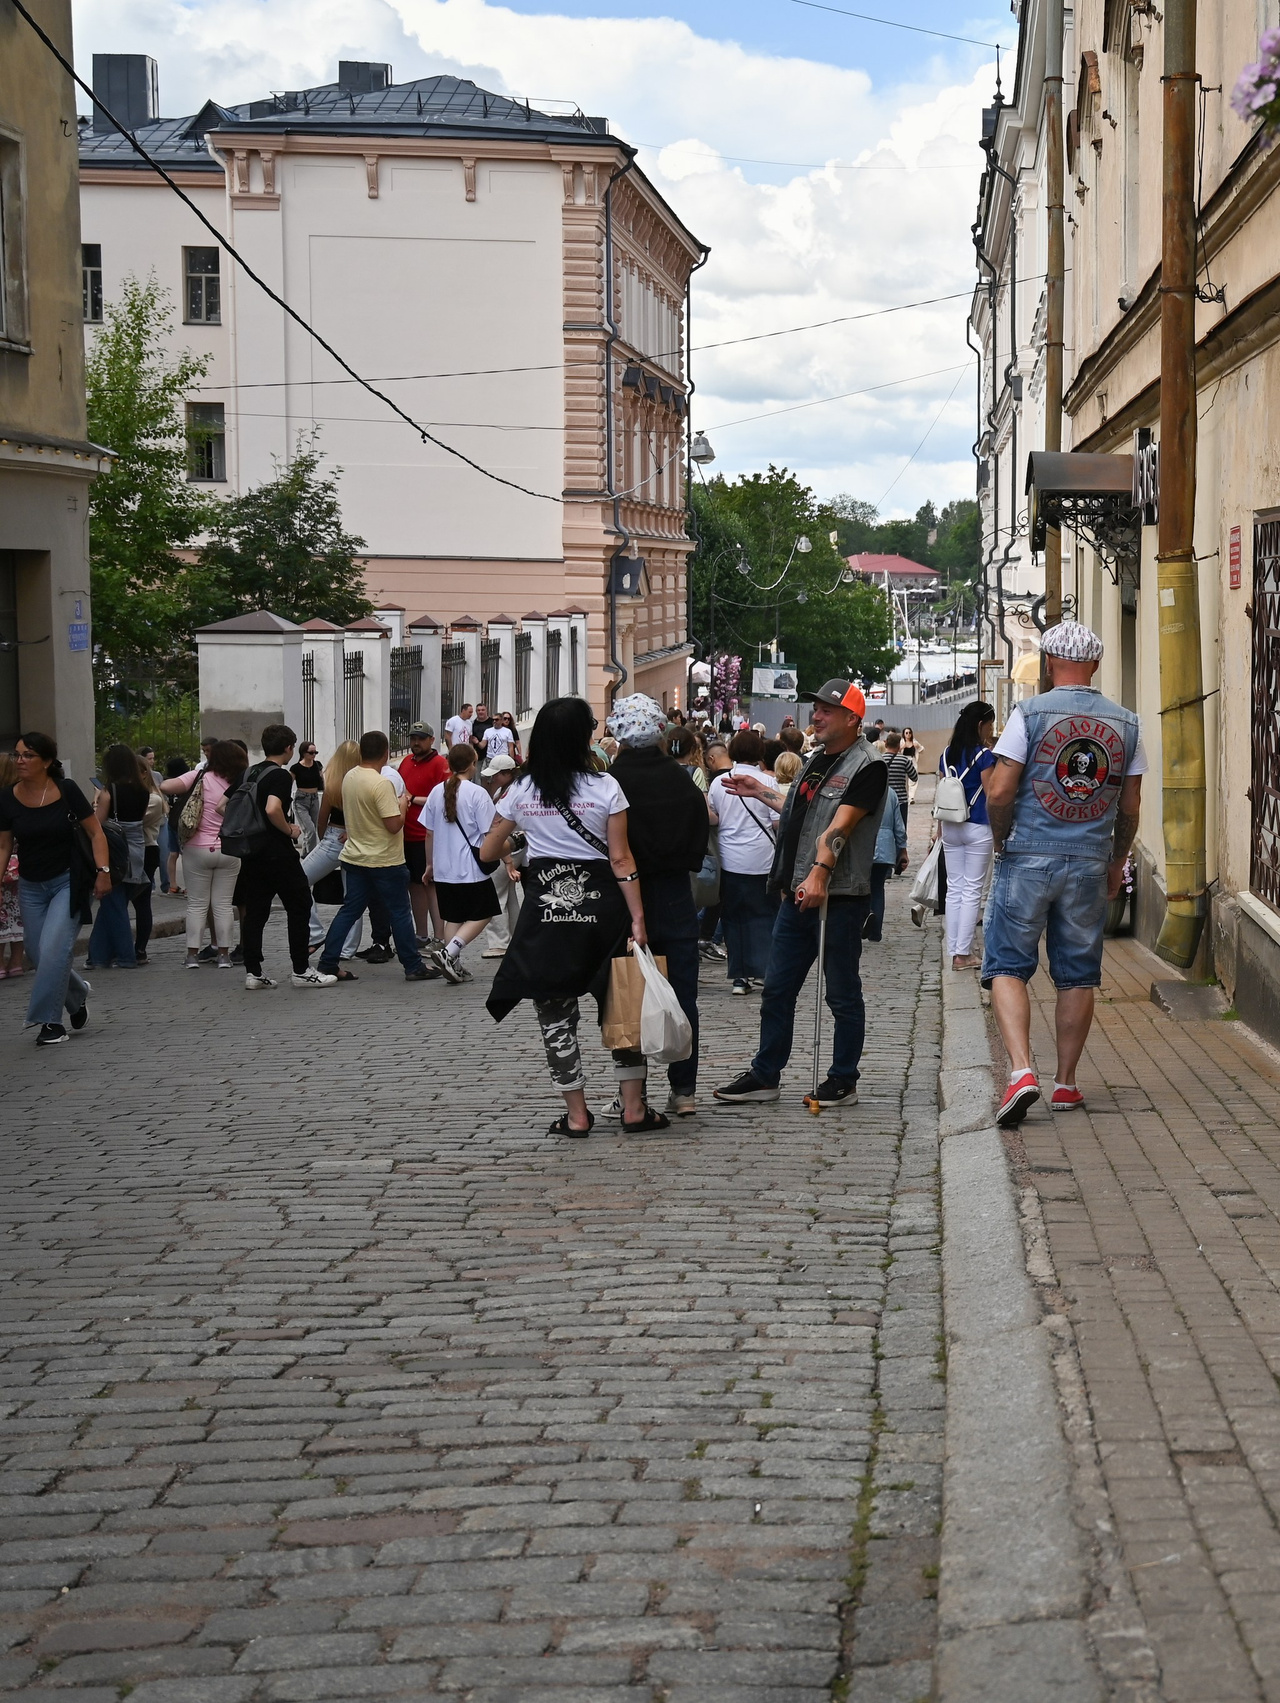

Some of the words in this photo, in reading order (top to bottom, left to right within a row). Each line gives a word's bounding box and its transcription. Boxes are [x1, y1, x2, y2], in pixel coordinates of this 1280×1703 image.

[1040, 719, 1123, 763] ПАДОНКИ
[1040, 790, 1110, 819] МАСКВА
[537, 862, 582, 886] Harley-
[541, 908, 598, 923] Davidson
